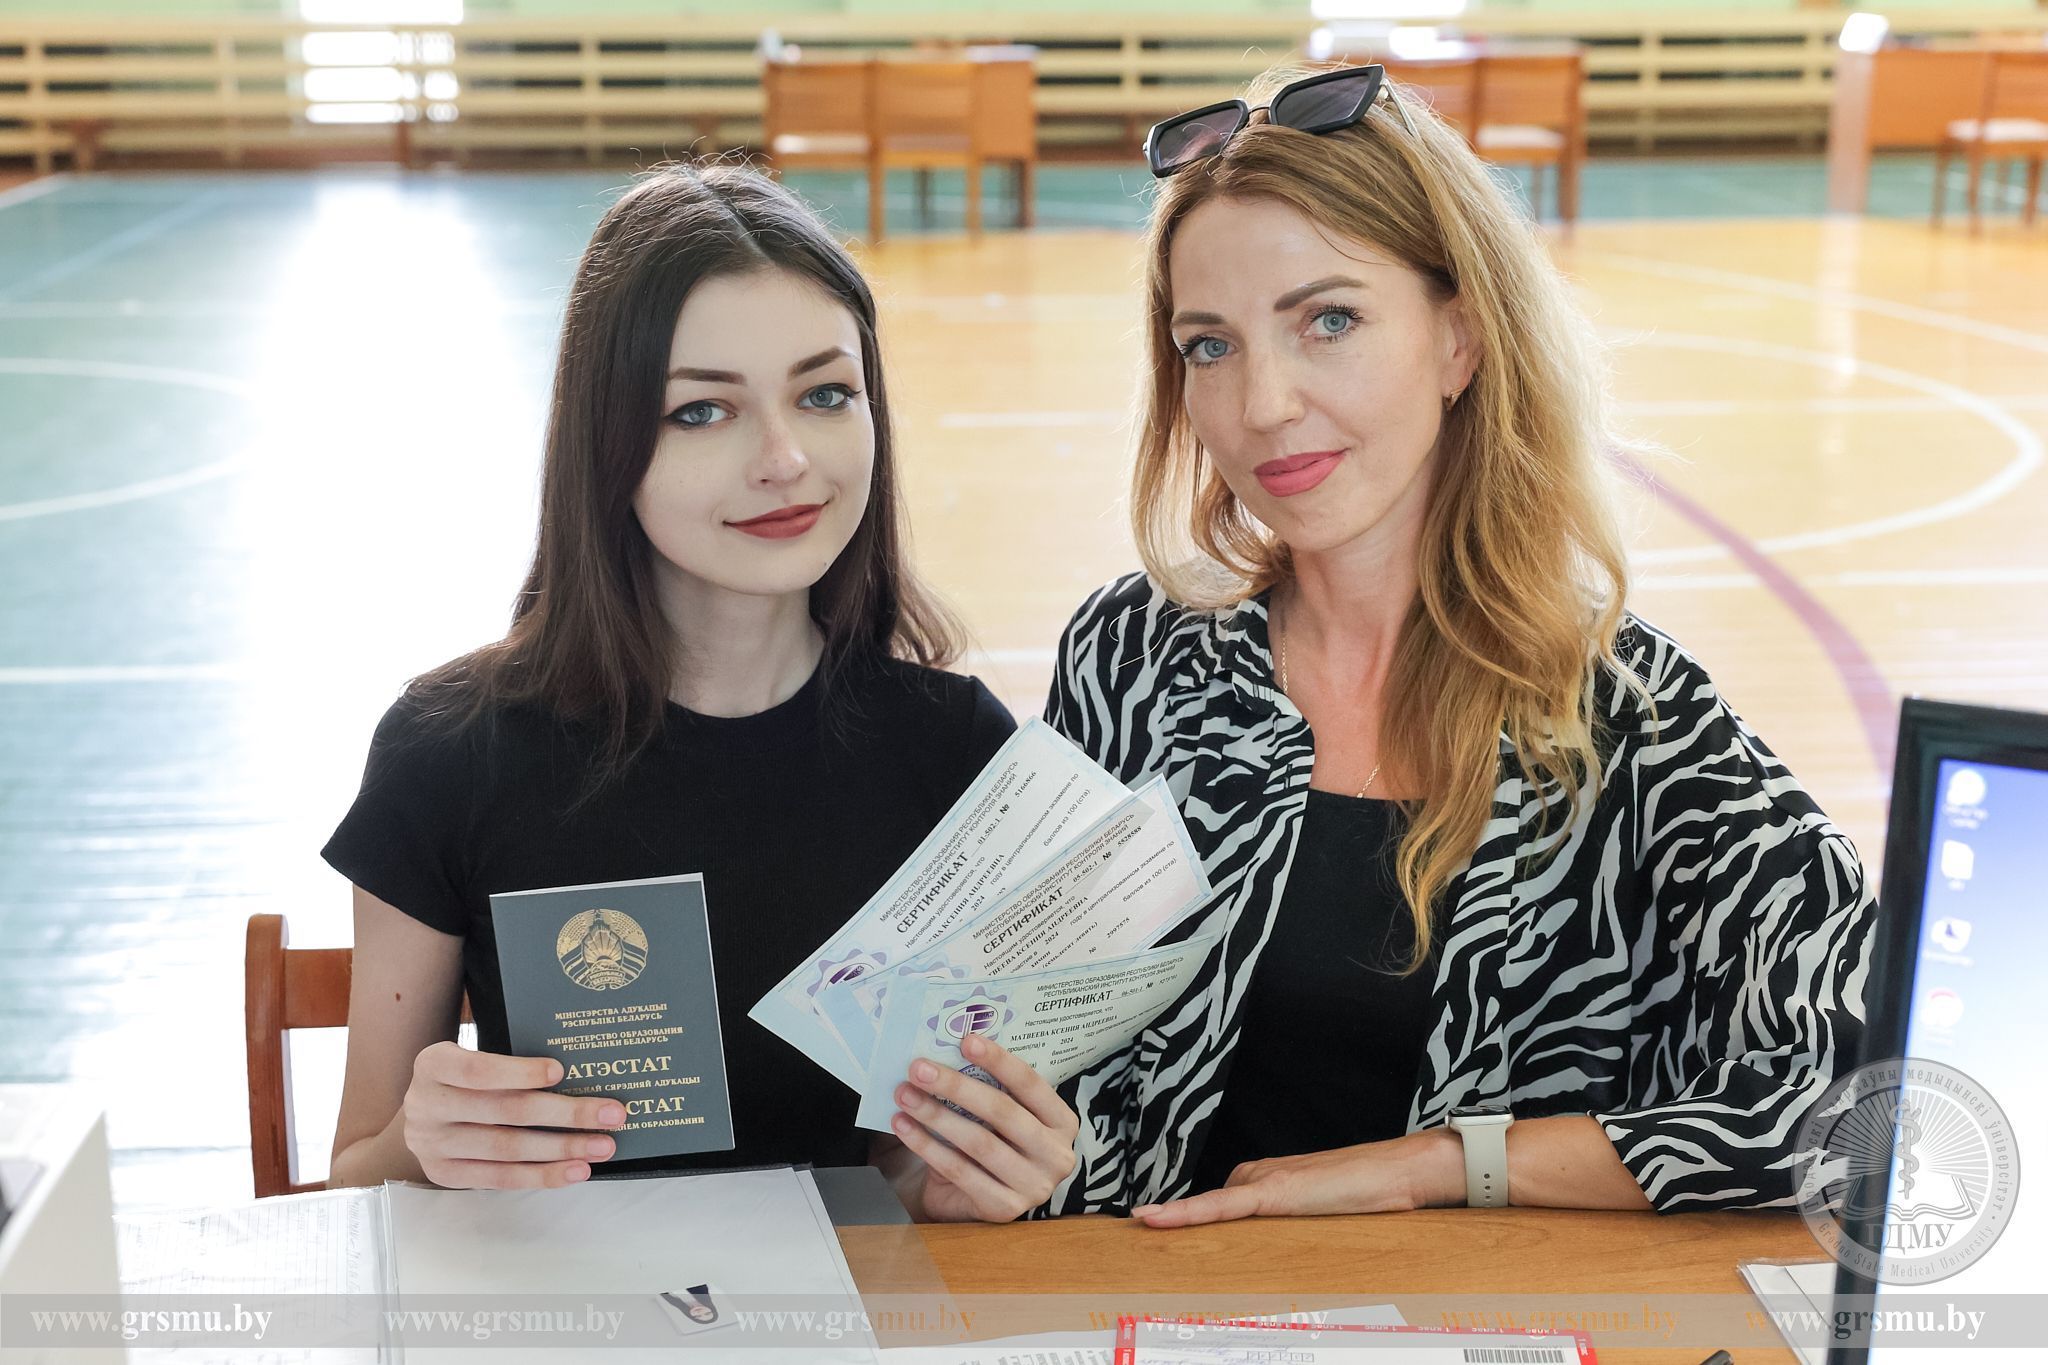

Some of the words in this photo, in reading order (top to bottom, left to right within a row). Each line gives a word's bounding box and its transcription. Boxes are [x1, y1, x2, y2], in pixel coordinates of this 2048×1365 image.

[1042, 823, 1063, 846] баллов
[1066, 803, 1077, 815] 100
[1075, 788, 1091, 805] (ста)
[879, 872, 924, 924] МИНИСТЕРСТВО
[920, 830, 961, 877] ОБРАЗОВАНИЯ
[957, 791, 993, 832] РЕСПУБЛИКИ
[989, 759, 1019, 793] БЕЛАРУСЬ
[893, 860, 945, 920] РЕСПУБЛИКАНСКИЙ
[941, 830, 971, 864] ИНСТИТУТ
[968, 798, 998, 832] КОНТРОЛЯ
[994, 772, 1018, 799] ЗНАНИЙ
[970, 894, 986, 911] 2024
[988, 870, 1003, 886] году
[1001, 808, 1053, 867] централизованном
[1047, 780, 1073, 810] экзамене
[895, 849, 970, 936] СЕРТИФИКАТ
[998, 802, 1010, 814] №
[972, 898, 1023, 941] МИНИСТЕРСТВО
[1021, 864, 1066, 903] ОБРАЗОВАНИЯ
[1065, 835, 1104, 869] РЕСПУБЛИКИ
[1102, 811, 1135, 839] БЕЛАРУСЬ
[983, 889, 1044, 941] РЕСПУБЛИКАНСКИЙ
[1042, 867, 1074, 895] ИНСТИТУТ
[1072, 842, 1106, 870] КОНТРОЛЯ
[1103, 822, 1129, 845] ЗНАНИЙ
[1150, 867, 1163, 879] 100
[904, 913, 937, 950] Настоящим
[934, 866, 978, 917] удостоверяется,
[974, 855, 986, 868] что
[941, 896, 970, 929] КСЕНИЯ
[965, 852, 1006, 899] АНДРЕЕВНА
[981, 884, 1066, 956] СЕРТИФИКАТ
[1100, 849, 1112, 861] №
[1043, 930, 1059, 945] 2024
[1086, 866, 1141, 912] централизованном
[983, 940, 1018, 970] Настоящим
[1064, 895, 1076, 905] что
[1015, 929, 1046, 956] КСЕНИЯ
[1046, 895, 1089, 931] АНДРЕЕВНА
[1036, 977, 1084, 993] МИНИСТЕРСТВО
[1084, 970, 1126, 984] ОБРАЗОВАНИЯ
[1125, 962, 1160, 976] РЕСПУБЛИКИ
[1043, 981, 1100, 998] РЕСПУБЛИКАНСКИЙ
[1099, 977, 1128, 988] ИНСТИТУТ
[554, 1007, 618, 1020] МІНІСТЭРСТВА
[621, 1003, 667, 1014] АДУКАЦЫІ
[1033, 989, 1114, 1013] СЕРТИФИКАТ
[562, 1016, 615, 1027] РЭСПУБЛІКІ
[617, 1012, 662, 1023] БЕЛАРУСЬ
[1010, 1029, 1049, 1042] МАТВЕЕВА
[1050, 1022, 1080, 1035] КСЕНИЯ
[1024, 1015, 1057, 1027] Настоящим
[547, 1032, 617, 1045] МИНИСТЕРСТВО
[619, 1026, 683, 1038] ОБРАЗОВАНИЯ
[562, 1039, 621, 1051] РЕСПУБЛИКИ
[623, 1035, 668, 1045] БЕЛАРУСЬ
[1059, 1036, 1074, 1044] 2024
[565, 1055, 672, 1079] АТЭСТАТ
[604, 1079, 651, 1091] СЯРЭДНЯЙ
[654, 1076, 700, 1087] АДУКАЦЫІ
[641, 1116, 704, 1128] ОБРАЗОВАНИИ
